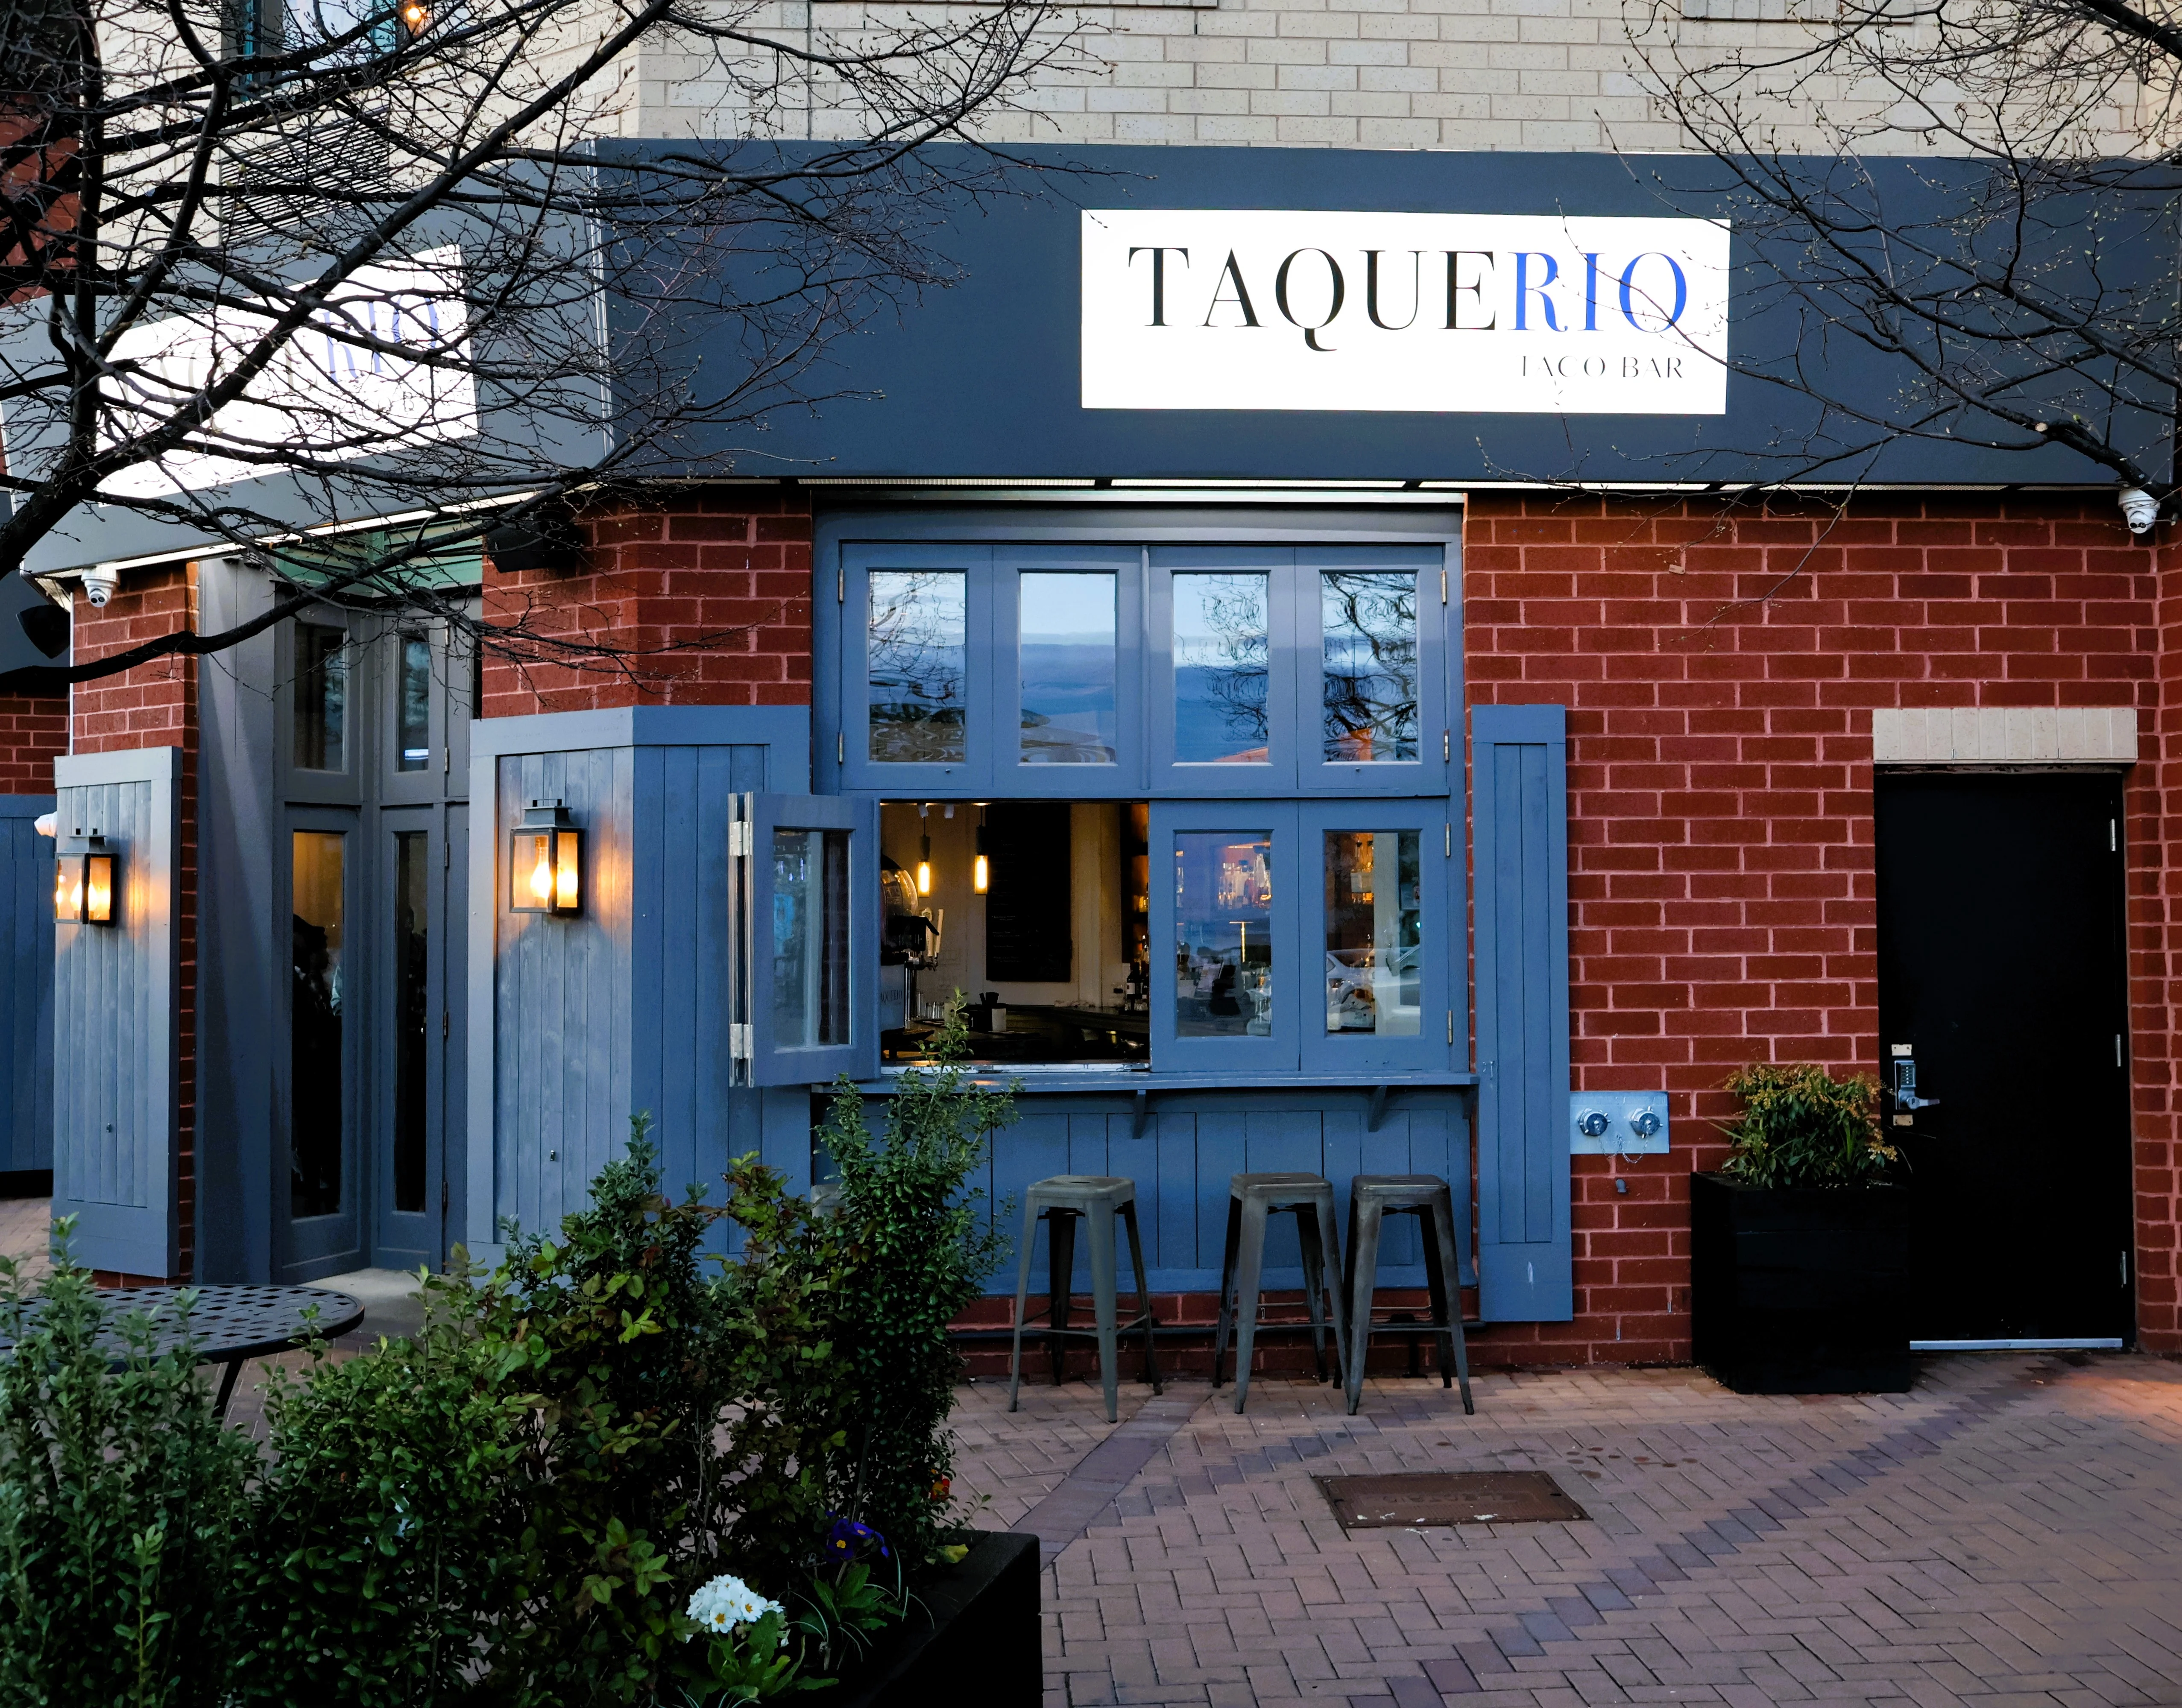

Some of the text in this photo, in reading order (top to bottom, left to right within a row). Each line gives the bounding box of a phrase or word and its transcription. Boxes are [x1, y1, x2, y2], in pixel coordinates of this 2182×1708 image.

[1128, 247, 1687, 351] TAQUERIO
[1517, 356, 1683, 378] TACO BAR
